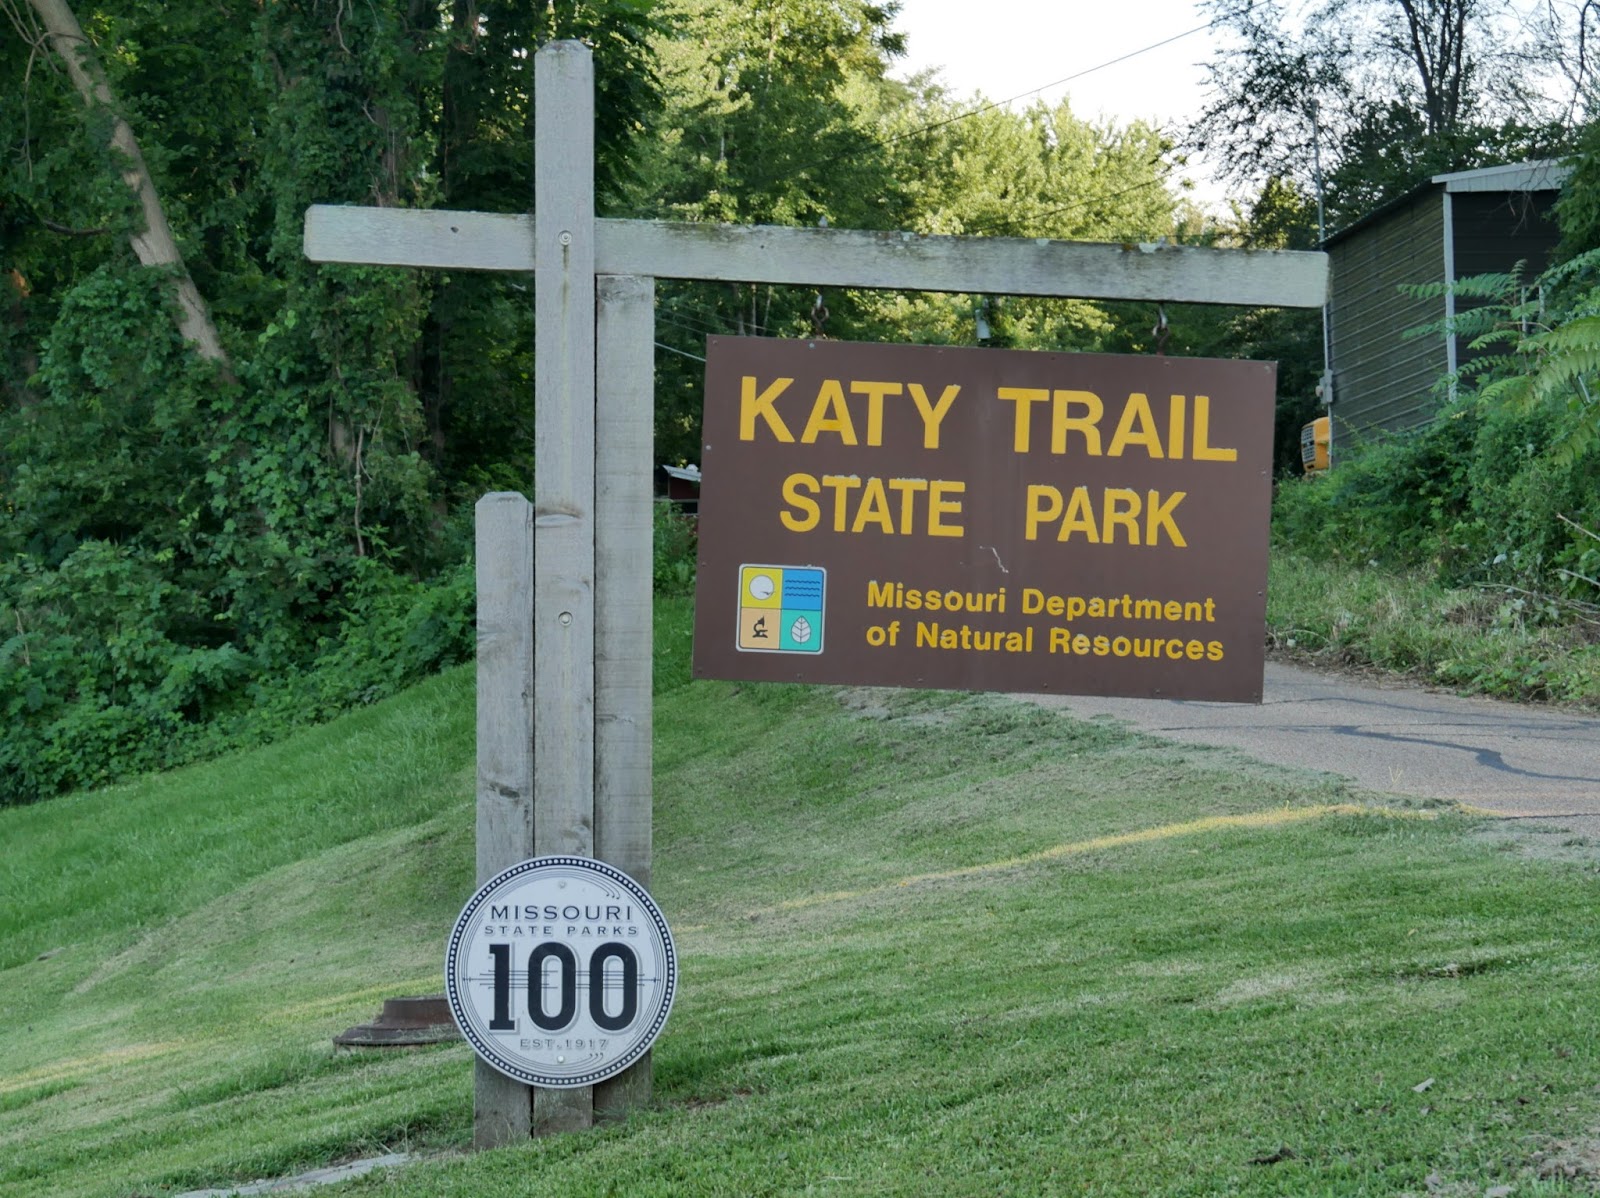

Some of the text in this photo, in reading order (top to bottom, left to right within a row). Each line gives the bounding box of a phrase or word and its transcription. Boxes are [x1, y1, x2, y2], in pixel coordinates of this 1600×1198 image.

[739, 375, 1238, 462] KATY TRAIL
[779, 473, 1188, 548] STATE PARK
[867, 580, 1216, 623] Missouri Department
[866, 622, 1224, 661] of Natural Resources
[484, 925, 638, 935] STATE PARKS
[491, 905, 632, 921] MISSOURI
[488, 941, 638, 1031] 100
